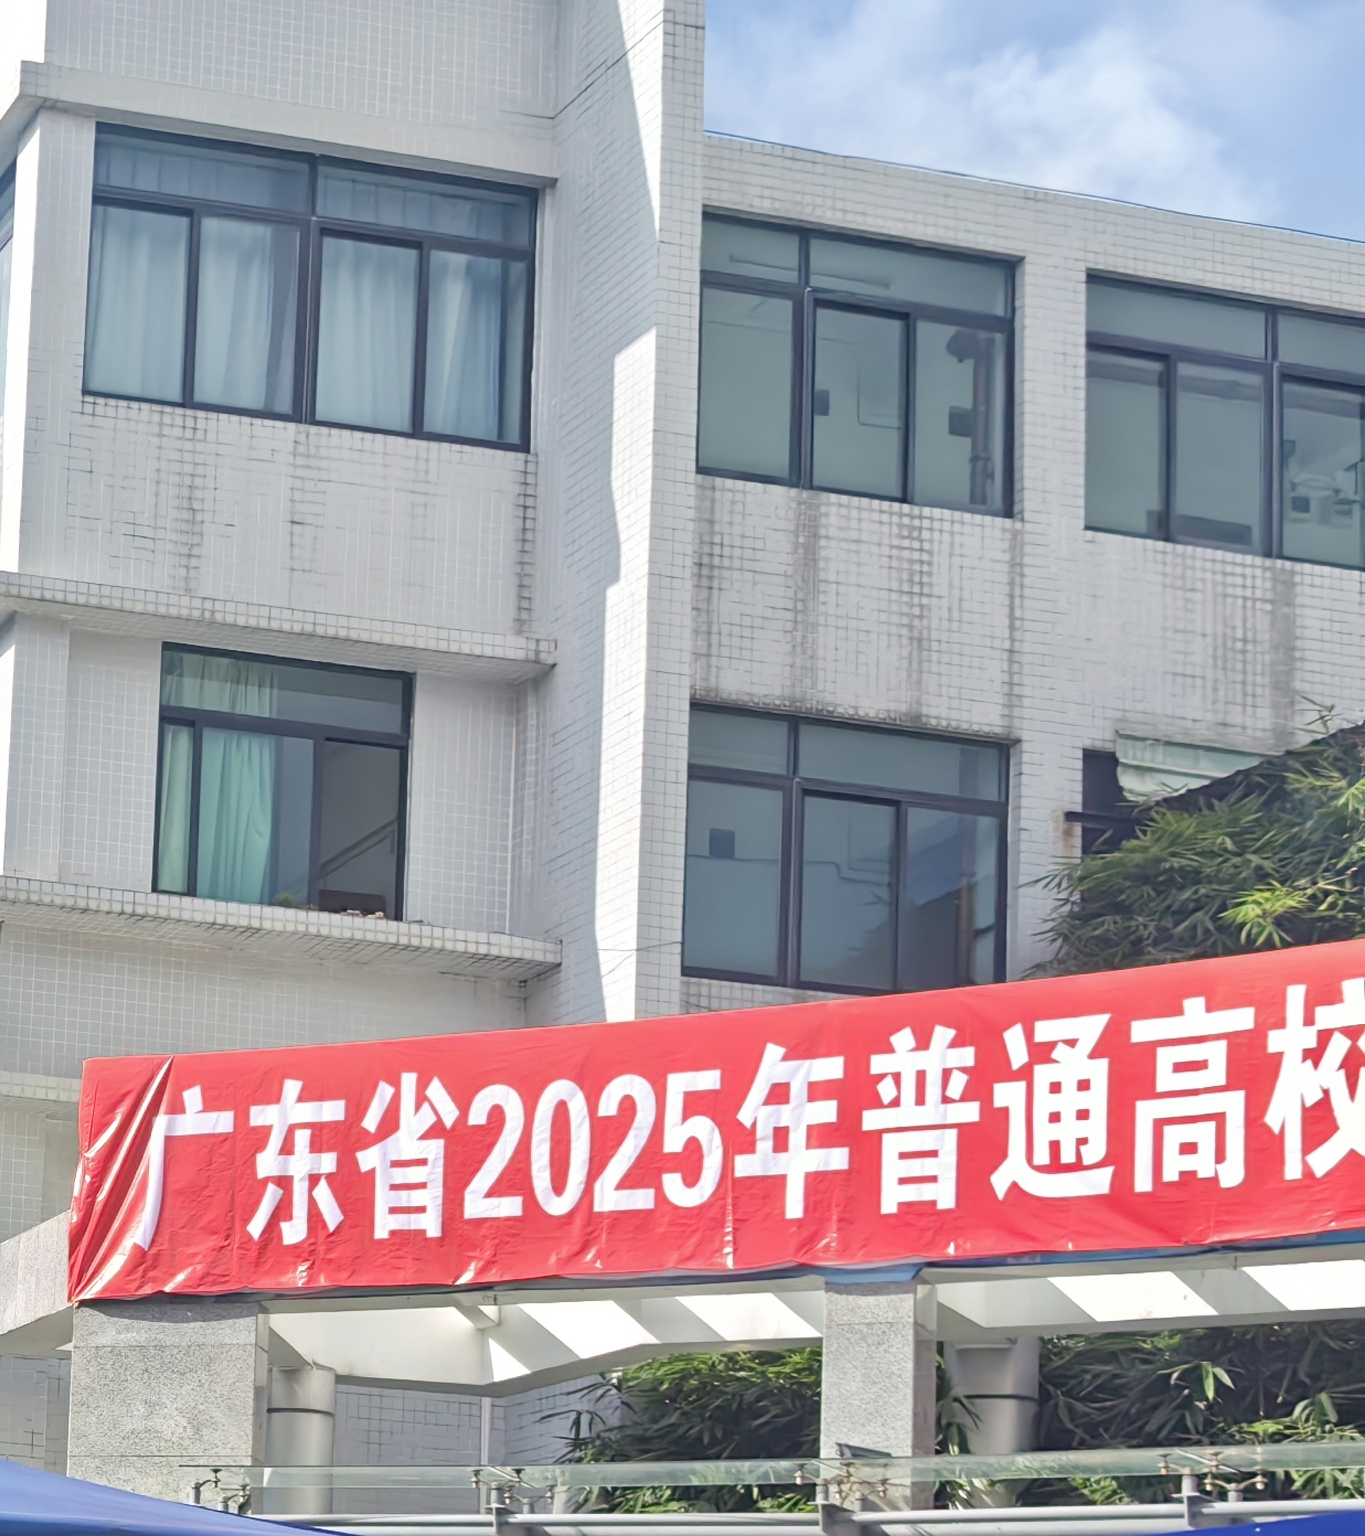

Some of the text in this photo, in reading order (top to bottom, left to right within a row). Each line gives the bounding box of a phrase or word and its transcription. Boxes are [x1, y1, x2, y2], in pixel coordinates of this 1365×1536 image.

[131, 982, 1365, 1252] 广东省2025年普通高校
